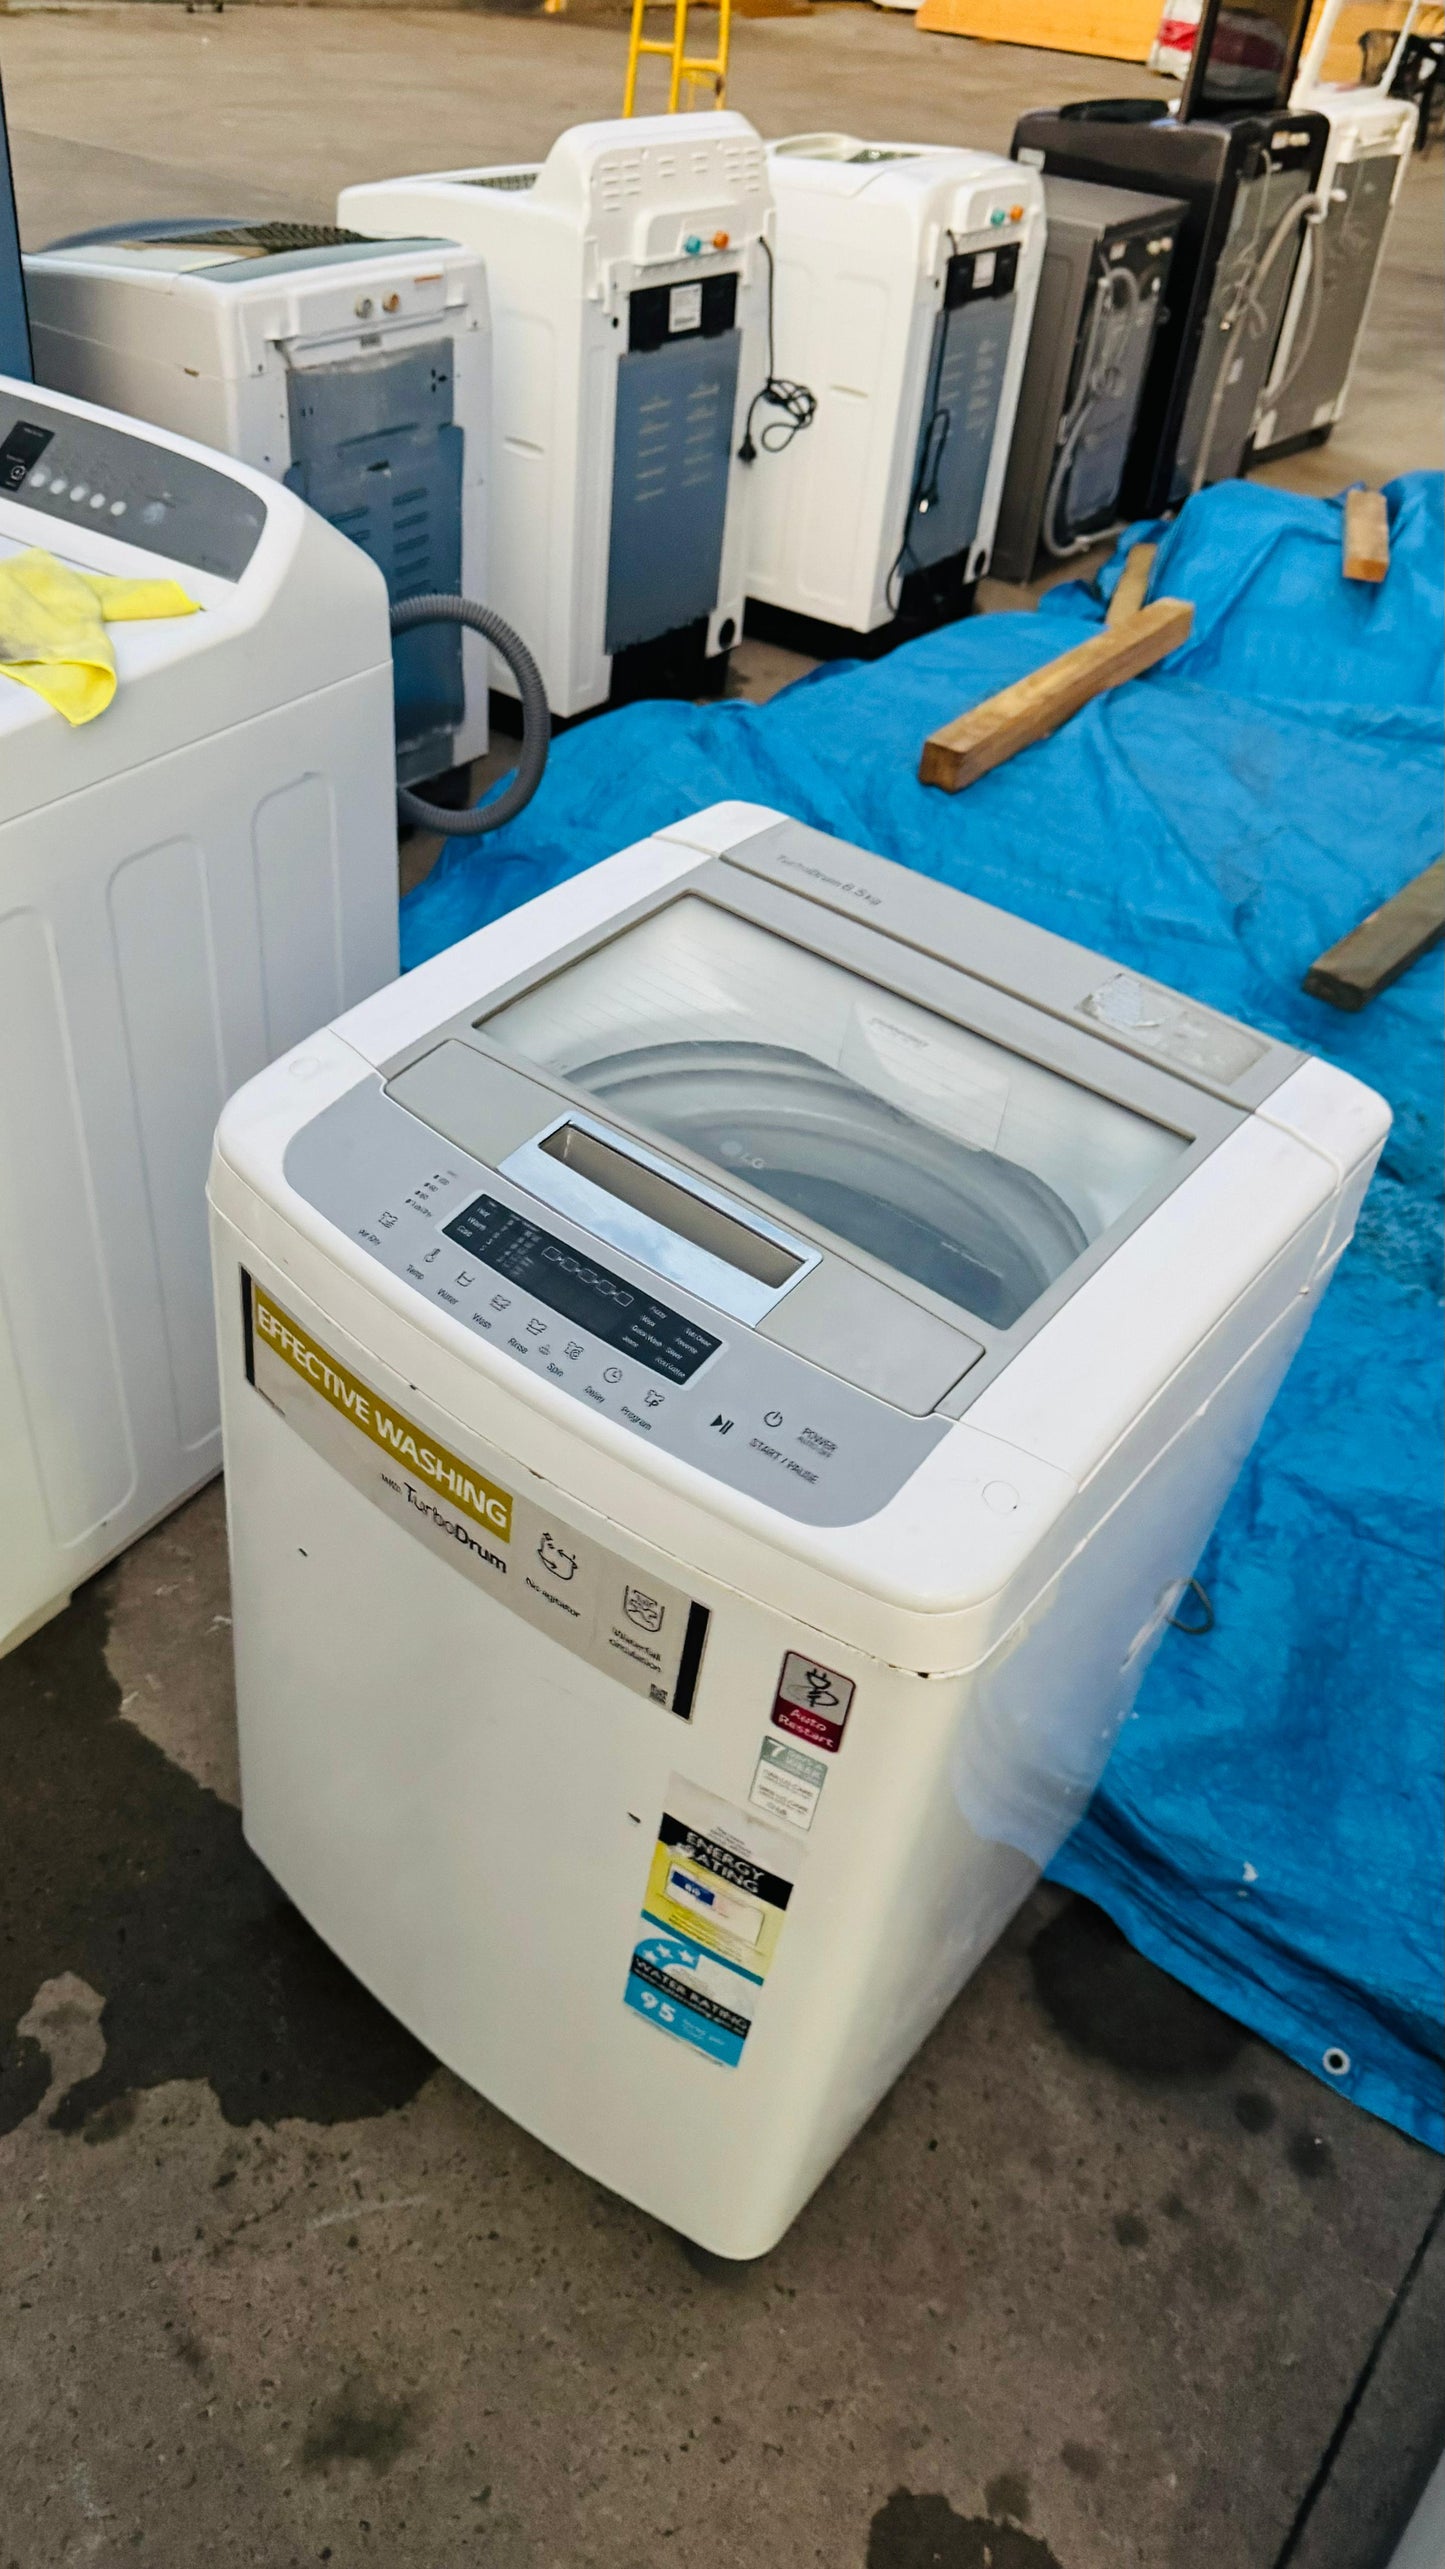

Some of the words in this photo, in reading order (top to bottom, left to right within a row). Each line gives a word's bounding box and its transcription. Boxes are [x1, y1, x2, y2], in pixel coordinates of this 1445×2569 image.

[472, 1313, 492, 1330] Wash
[508, 1337, 529, 1355] Rinse
[546, 1362, 564, 1378] Spin
[257, 1304, 370, 1425] EFFECTIVE
[375, 1410, 507, 1528] WASHING
[621, 1406, 652, 1431] Program
[802, 1427, 838, 1451] POWER
[749, 1438, 782, 1461] START
[787, 1460, 819, 1484] PAUSE
[404, 1481, 507, 1574] TurboDrum
[778, 1713, 834, 1748] Restart
[790, 1708, 827, 1732] Auto
[767, 1739, 786, 1758] 7
[686, 1831, 765, 1880] ENERGY
[636, 1957, 687, 1996] WATER
[690, 1992, 747, 2029] RATING
[640, 1991, 676, 2023] 95
